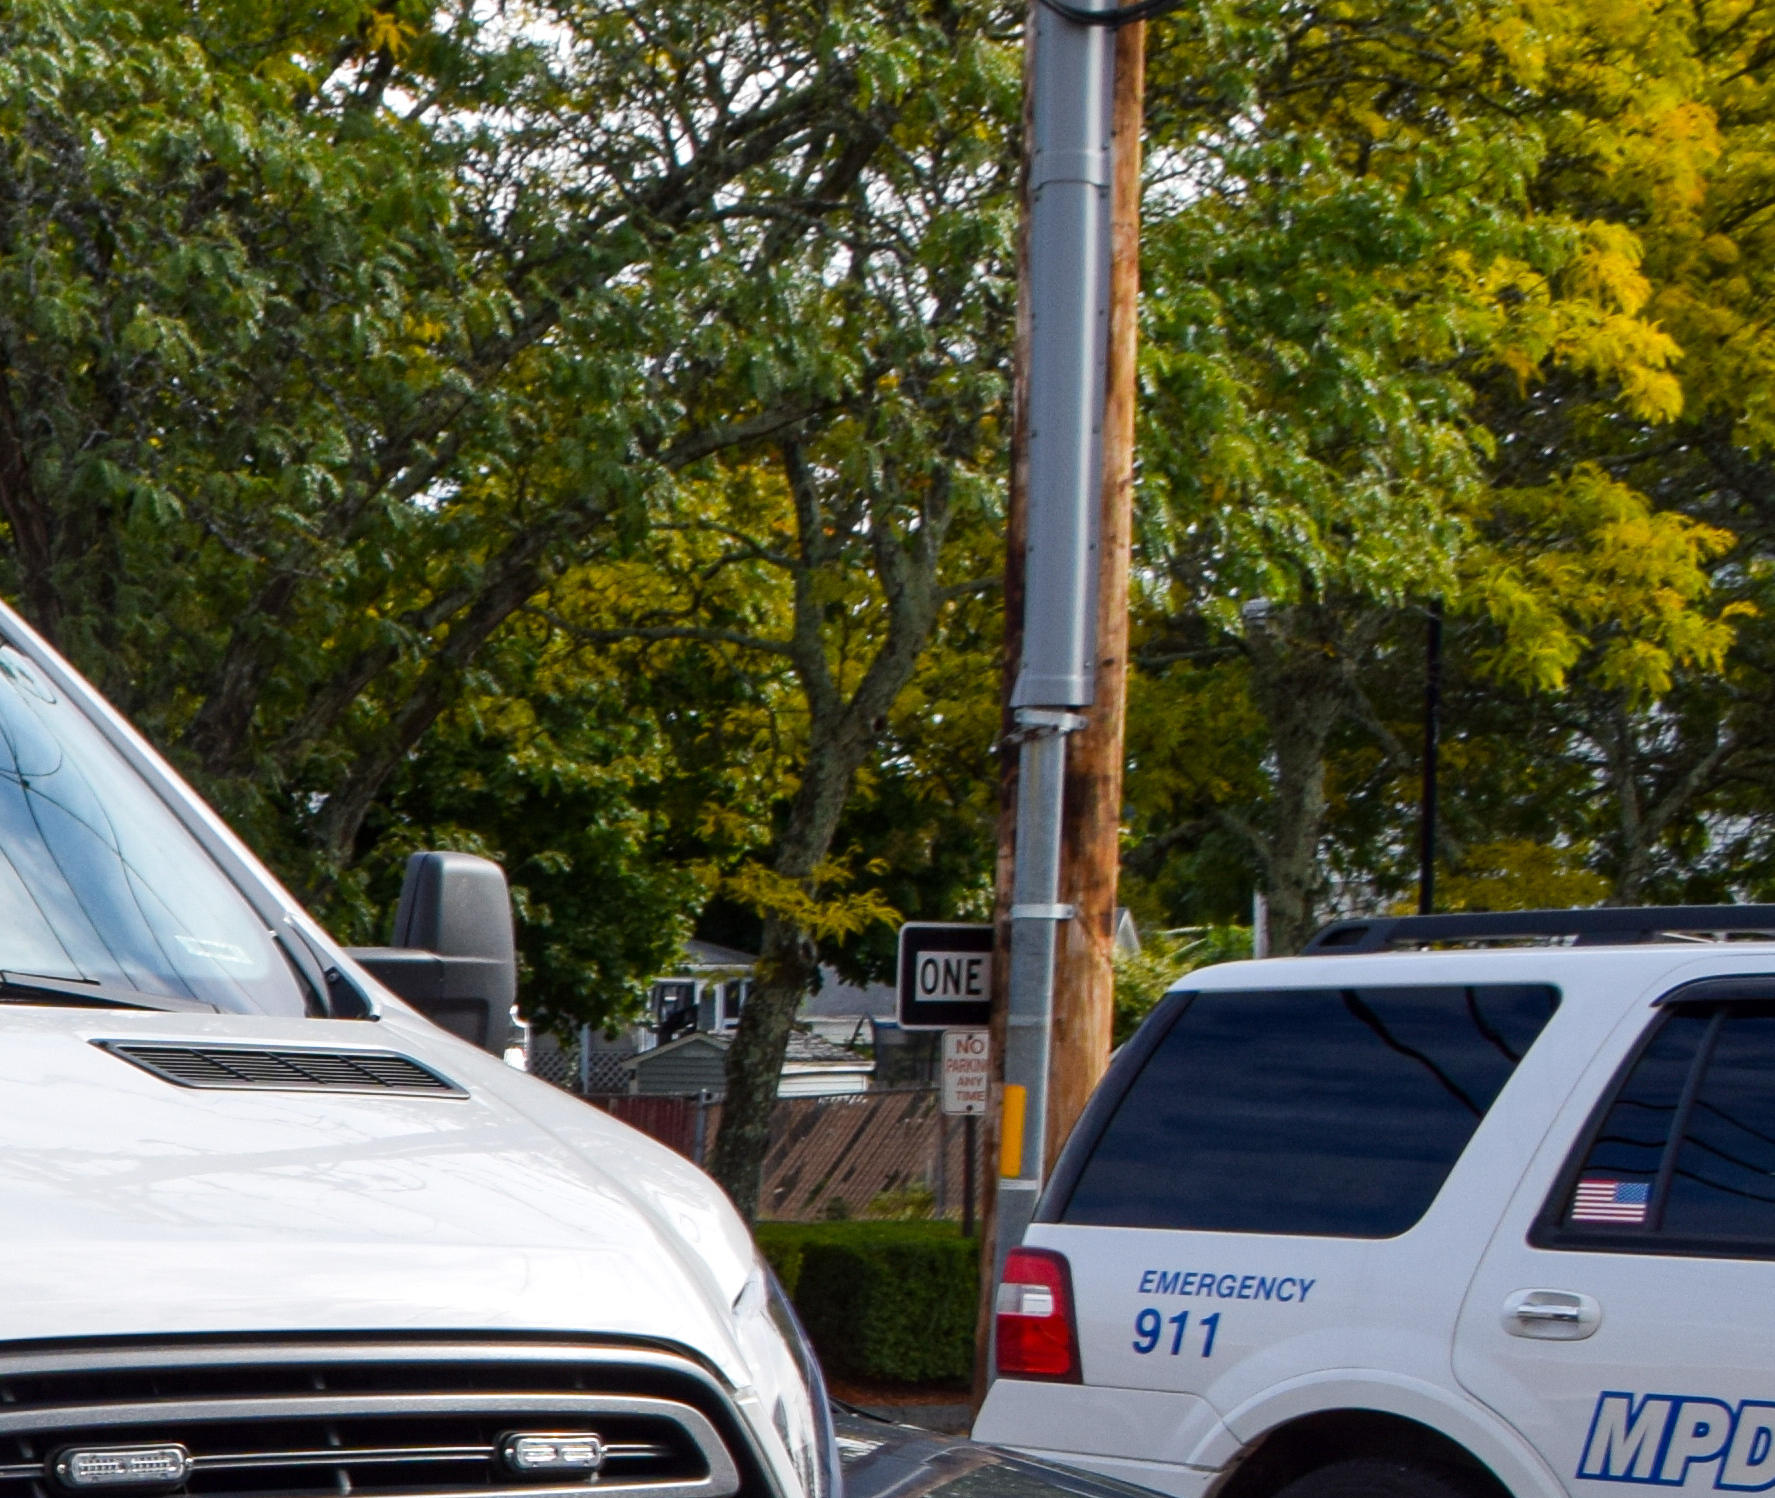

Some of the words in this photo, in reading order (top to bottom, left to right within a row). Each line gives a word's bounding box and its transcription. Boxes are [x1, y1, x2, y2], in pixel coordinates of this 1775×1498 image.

[920, 957, 982, 996] ONE
[956, 1039, 984, 1055] NO
[947, 1058, 988, 1074] PARKIN
[956, 1076, 982, 1087] ANY
[956, 1090, 985, 1101] TIME
[1138, 1270, 1316, 1303] EMERGENCY
[1132, 1307, 1221, 1358] 911
[1575, 1391, 1775, 1493] MPD
